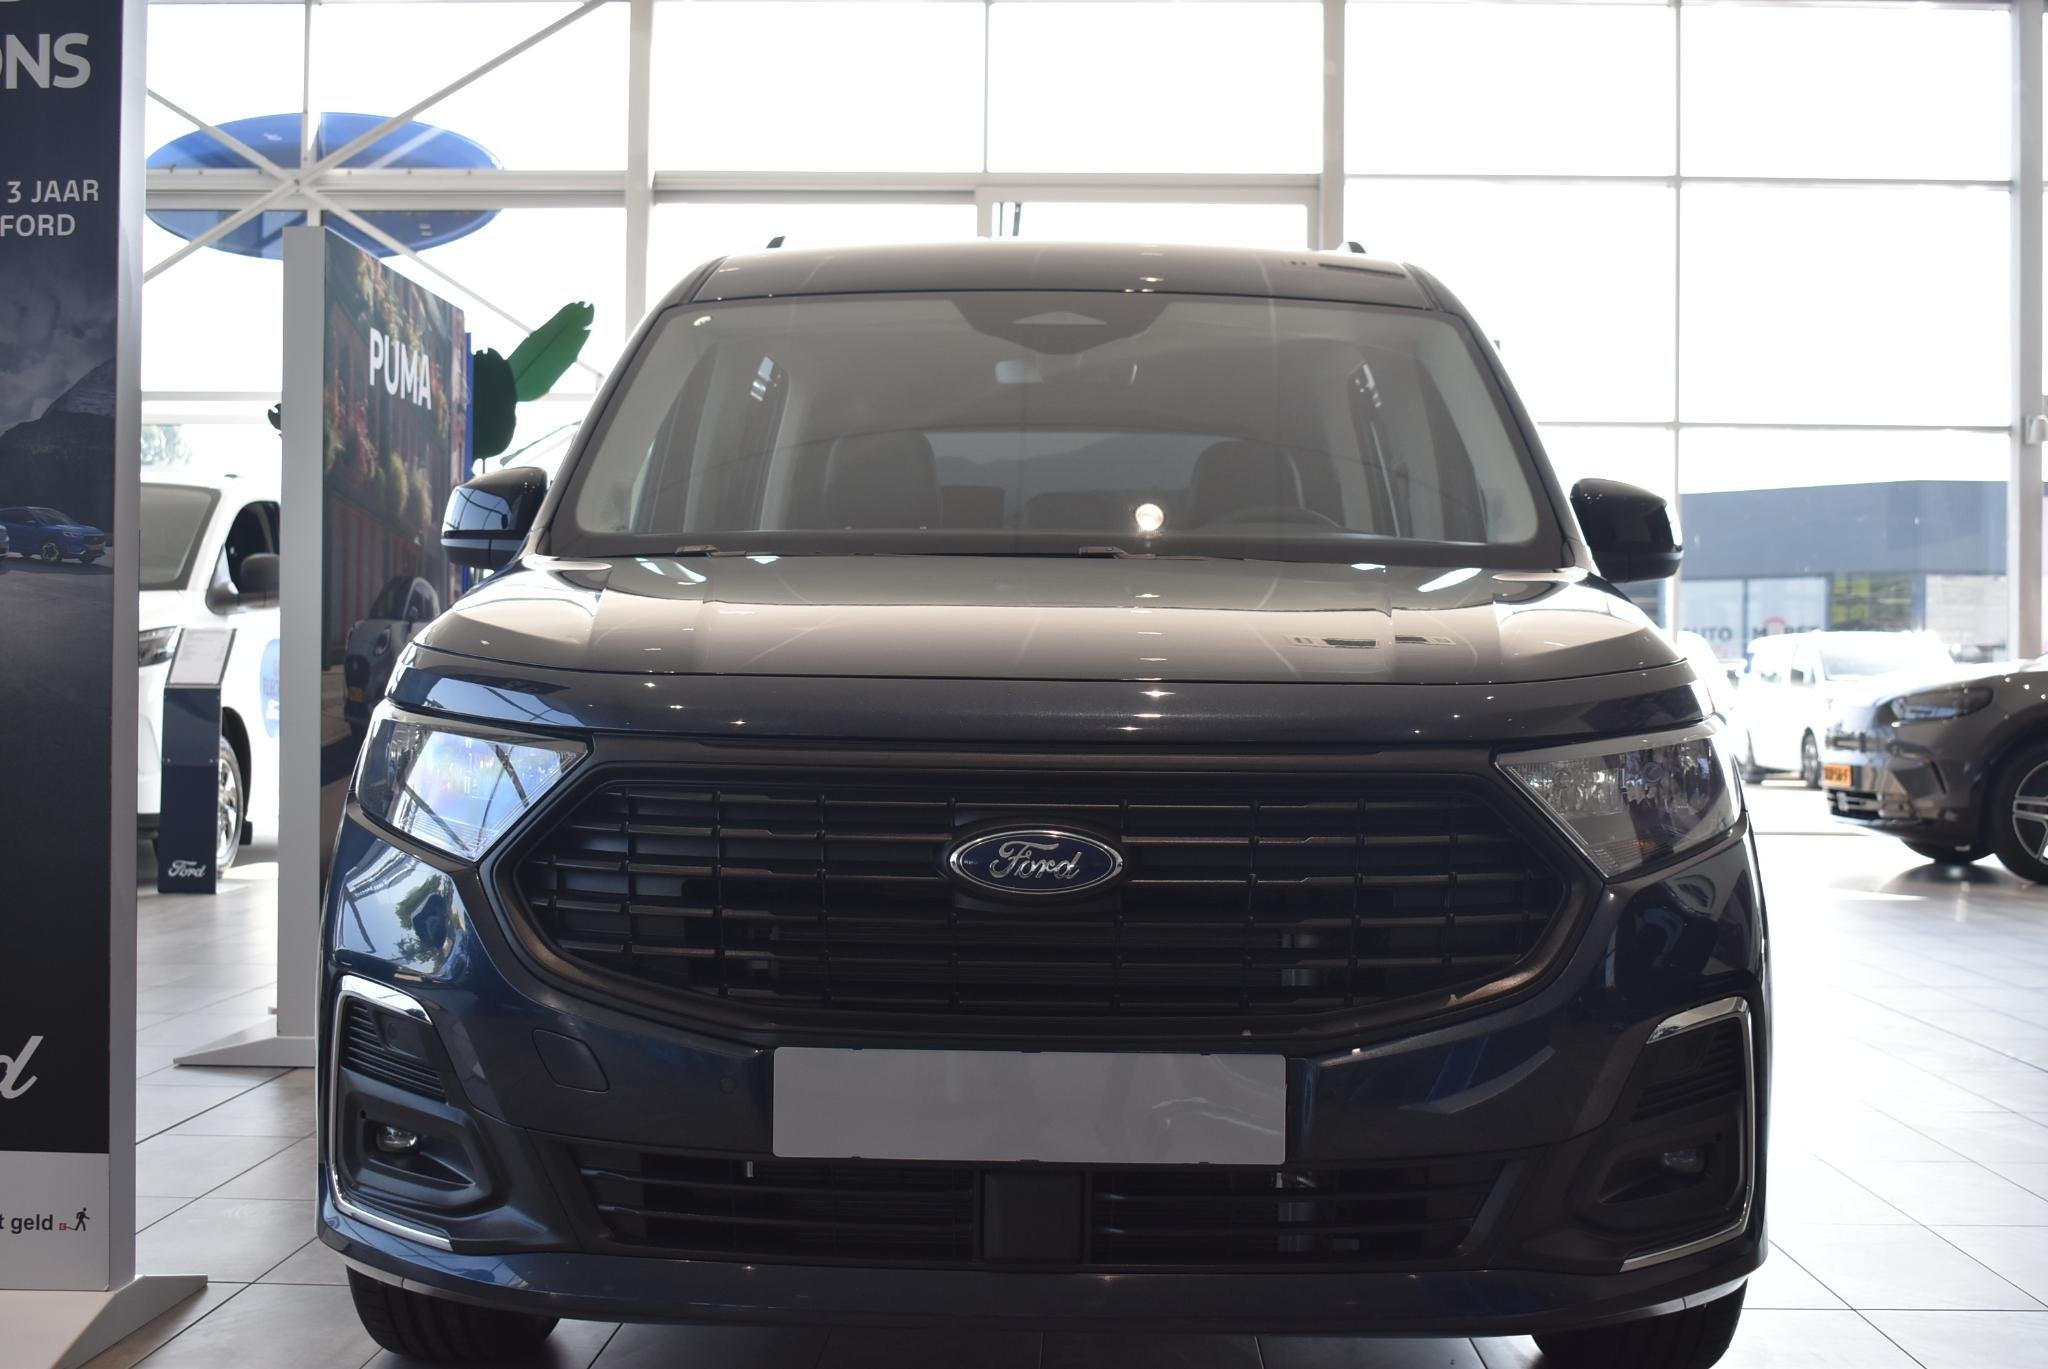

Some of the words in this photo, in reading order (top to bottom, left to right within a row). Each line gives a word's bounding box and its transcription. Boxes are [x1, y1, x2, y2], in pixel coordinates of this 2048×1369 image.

[0, 32, 91, 90] NS
[7, 181, 22, 203] 3
[31, 179, 99, 203] JAAR
[0, 213, 76, 237] FORD
[369, 327, 432, 410] PUMA
[168, 859, 207, 877] Ford
[989, 840, 1083, 879] Ford
[11, 1213, 54, 1235] geld
